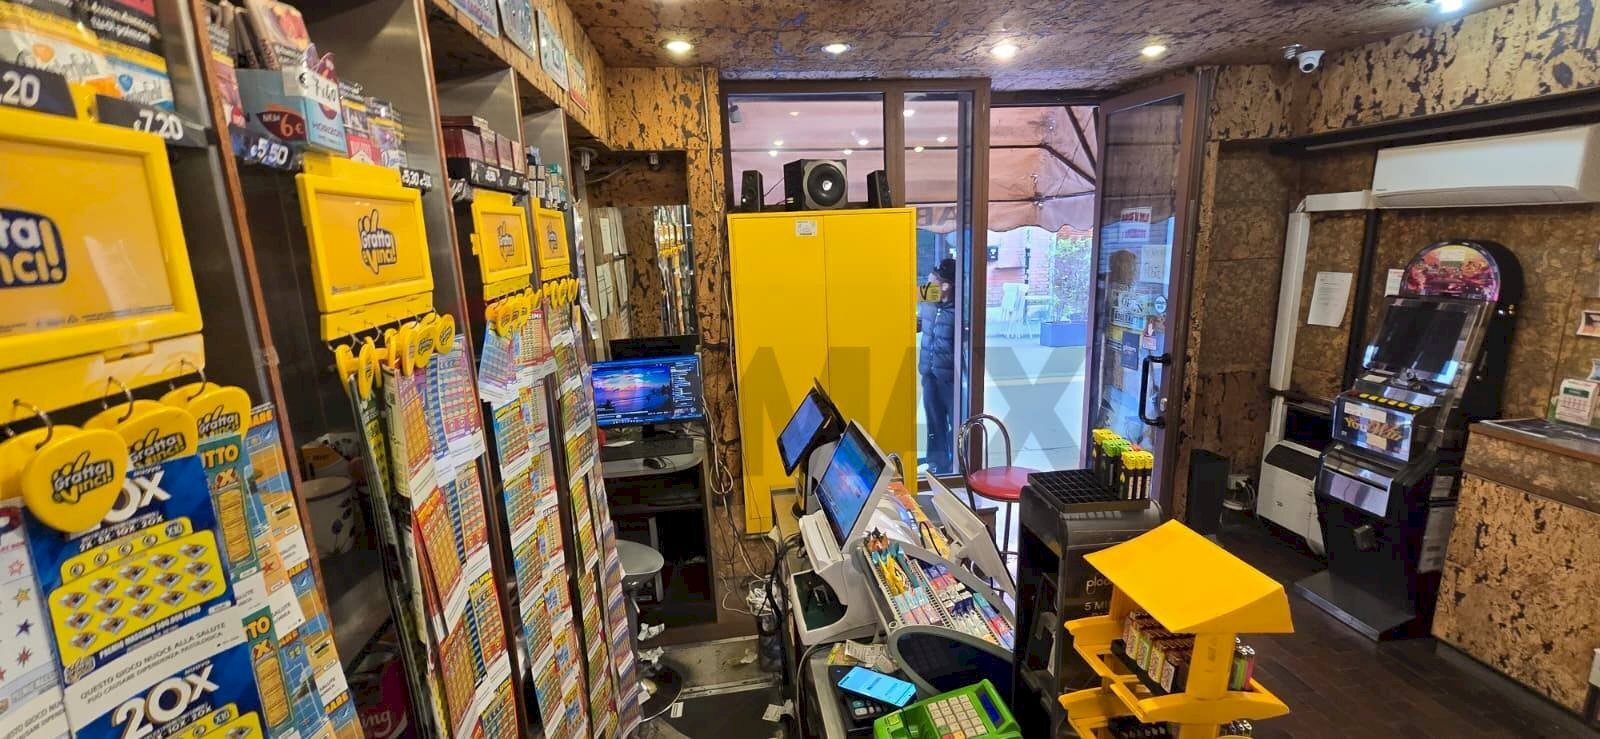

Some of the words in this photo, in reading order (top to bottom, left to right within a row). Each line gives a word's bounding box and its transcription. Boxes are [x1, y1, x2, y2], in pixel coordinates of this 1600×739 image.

[361, 230, 391, 249] Gratta
[54, 463, 106, 491] Gratta
[80, 676, 115, 701] QUESTO
[116, 660, 143, 680] GIOCO
[196, 622, 226, 640] SALUTE
[112, 664, 219, 739] 20X
